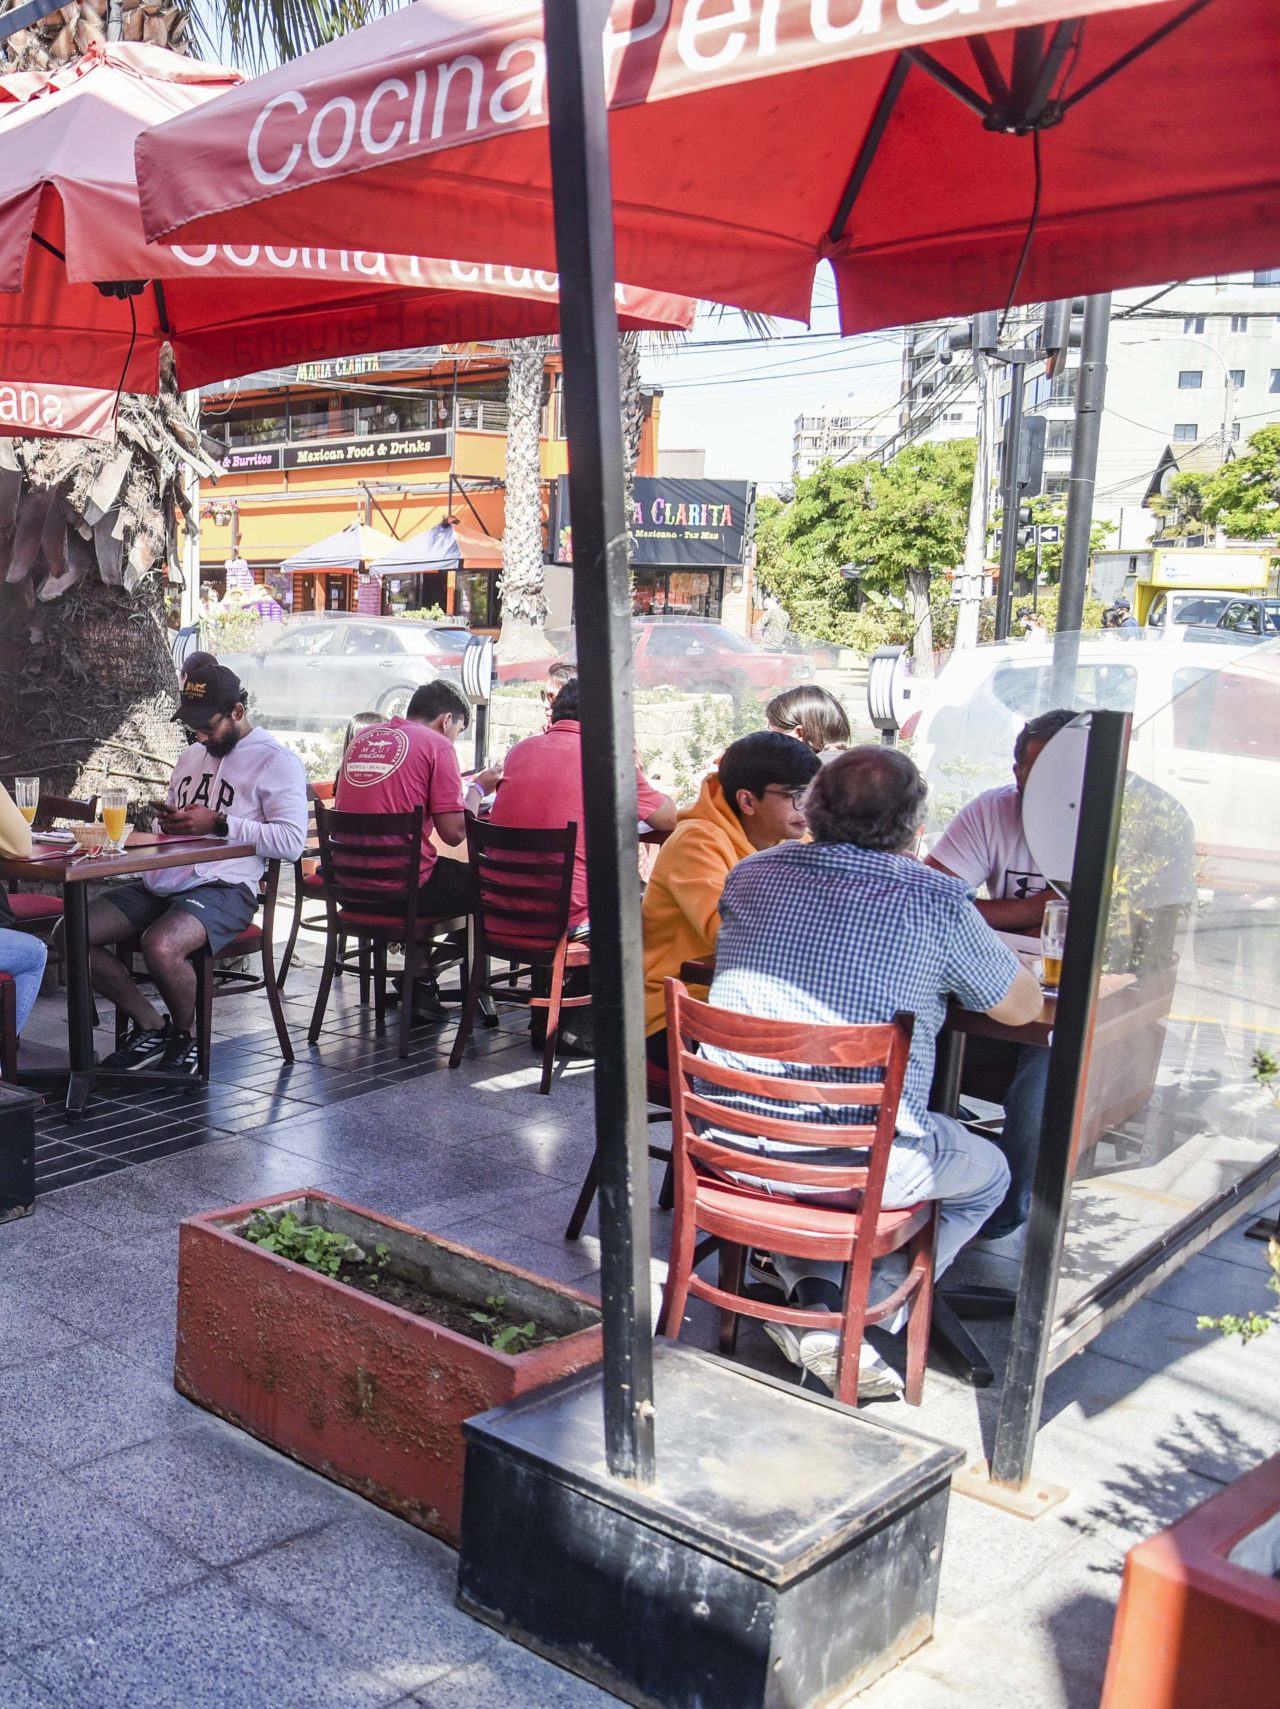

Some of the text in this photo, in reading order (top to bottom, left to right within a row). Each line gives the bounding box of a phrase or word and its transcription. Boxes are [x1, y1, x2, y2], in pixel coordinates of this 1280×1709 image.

[248, 0, 1018, 186] Cocina Peru
[335, 356, 380, 377] CLARITA
[232, 453, 272, 467] Burritos
[297, 440, 432, 463] Mexican Food & Drinks
[651, 498, 733, 527] CLARITA
[635, 529, 678, 540] Mexicana
[177, 773, 235, 812] GAP
